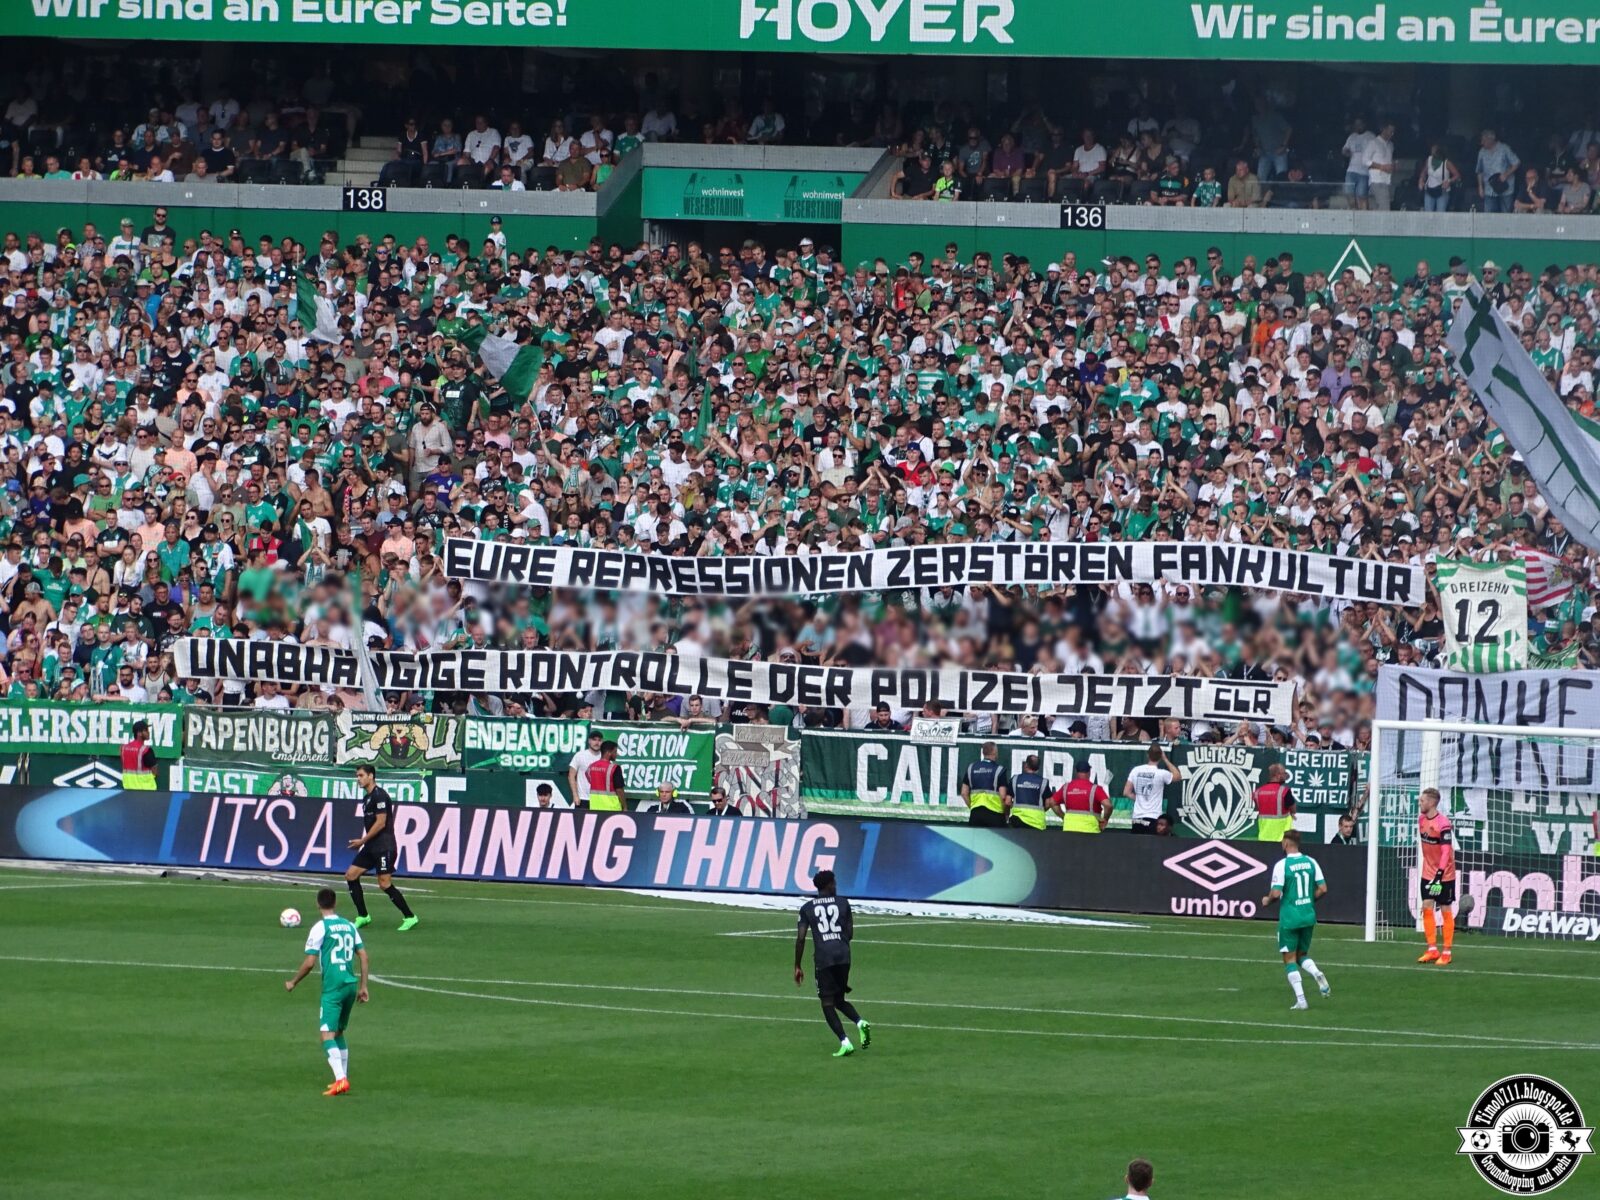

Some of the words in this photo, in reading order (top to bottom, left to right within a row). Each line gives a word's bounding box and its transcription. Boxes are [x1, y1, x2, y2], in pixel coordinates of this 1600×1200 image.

[223, 0, 279, 22] an
[292, 0, 421, 24] Eurer
[430, 0, 567, 26] Seite!
[740, 0, 1014, 43] HOYER
[1191, 4, 1276, 39] Wir
[1285, 4, 1385, 41] sind
[1396, 15, 1455, 42] an
[346, 189, 383, 209] 138
[701, 188, 744, 197] wohninvest
[802, 190, 845, 200] wohninvest
[683, 197, 743, 216] WESERSTADION
[1063, 206, 1102, 227] 136
[450, 540, 556, 583] EURE
[568, 550, 873, 595] REPRESSIONEN
[886, 545, 1133, 586] ZERSTÖREN
[1153, 544, 1412, 603] FANKULTUR
[1451, 581, 1510, 595] DREIZEHN
[1454, 598, 1501, 645] 12
[501, 652, 753, 699] KONTROLLE
[769, 664, 852, 707] DER
[871, 668, 1041, 713] POLIZEI
[1057, 674, 1200, 717] JETZT
[187, 713, 330, 754] PAPENBURG
[465, 720, 587, 753] ENDEAVOUR
[617, 732, 689, 758] SEKTION
[500, 753, 550, 767] 3000
[1194, 746, 1246, 766] ULTRAS
[1285, 751, 1349, 768] CREME
[188, 771, 259, 794] EAST
[620, 763, 698, 790] EISELUST
[1328, 771, 1349, 786] LA
[322, 779, 417, 802] UNIED
[1290, 787, 1349, 804] REMEN
[200, 796, 296, 867] IT'S
[300, 802, 333, 869] A
[355, 803, 637, 882] RAINING
[652, 814, 840, 892] THING
[381, 856, 386, 868] 5
[1294, 871, 1310, 899] 11
[1170, 894, 1257, 917] umbro
[814, 904, 842, 933] 32
[1502, 908, 1600, 941] betway
[330, 934, 354, 964] 28
